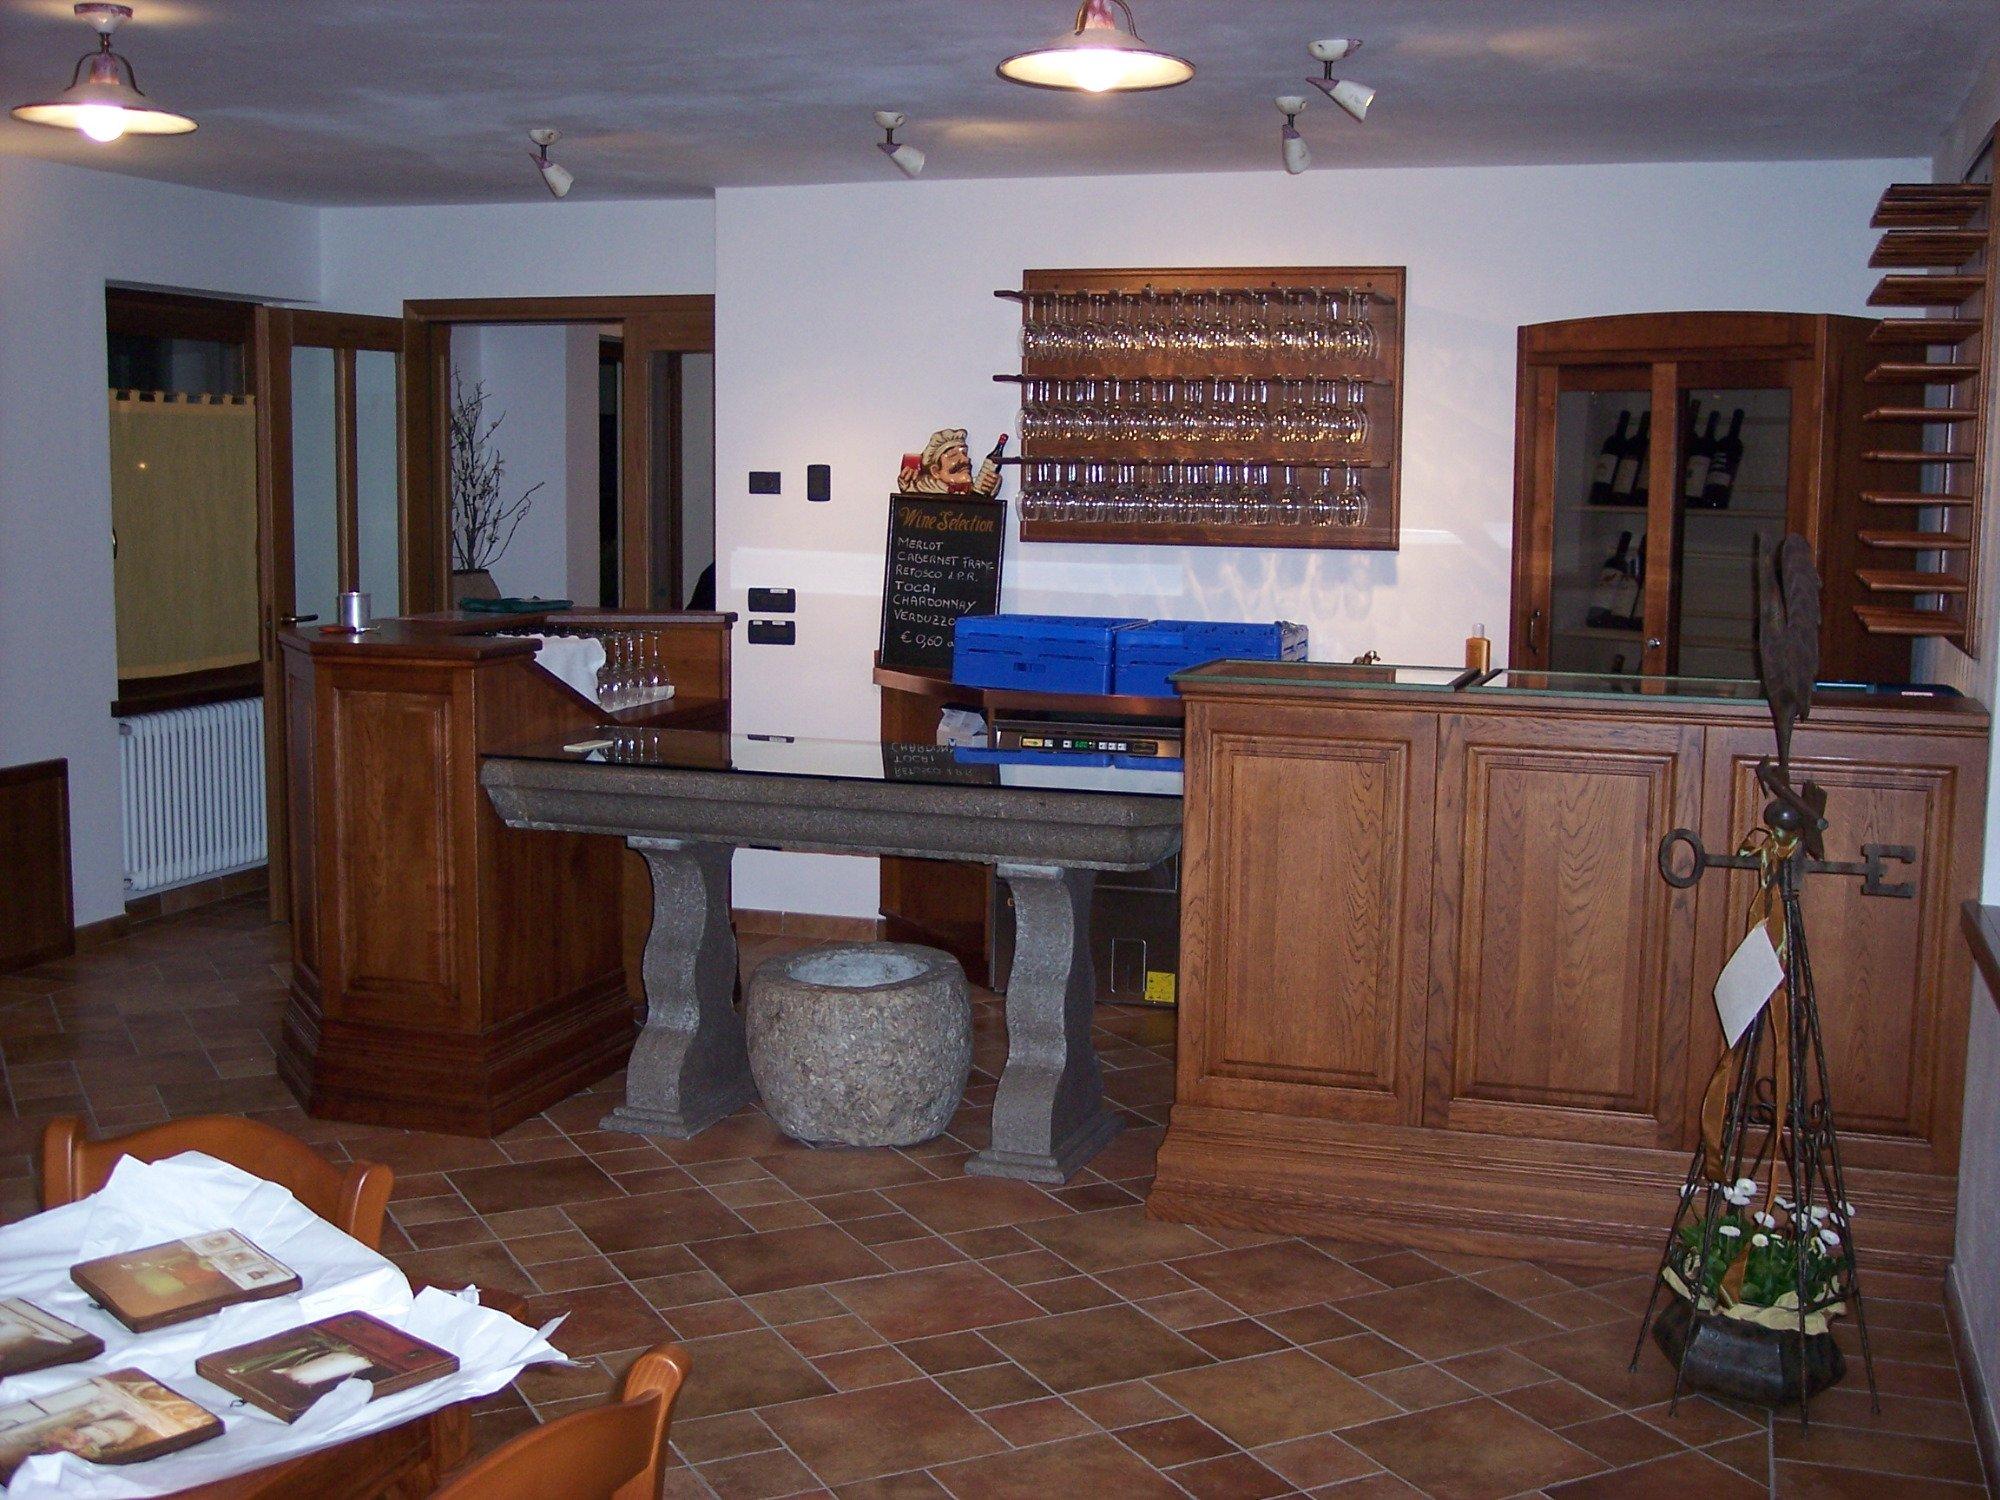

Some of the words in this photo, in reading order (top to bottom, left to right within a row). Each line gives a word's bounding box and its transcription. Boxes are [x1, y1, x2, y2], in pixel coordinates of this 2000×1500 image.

[901, 507, 936, 528] Wine
[937, 511, 993, 532] Selection
[898, 537, 943, 550] MERLOT
[898, 552, 958, 566] CABERNET
[895, 581, 936, 594] TOCAI
[893, 594, 976, 614] CHARDONNAY
[894, 609, 956, 626] VERDUZZO
